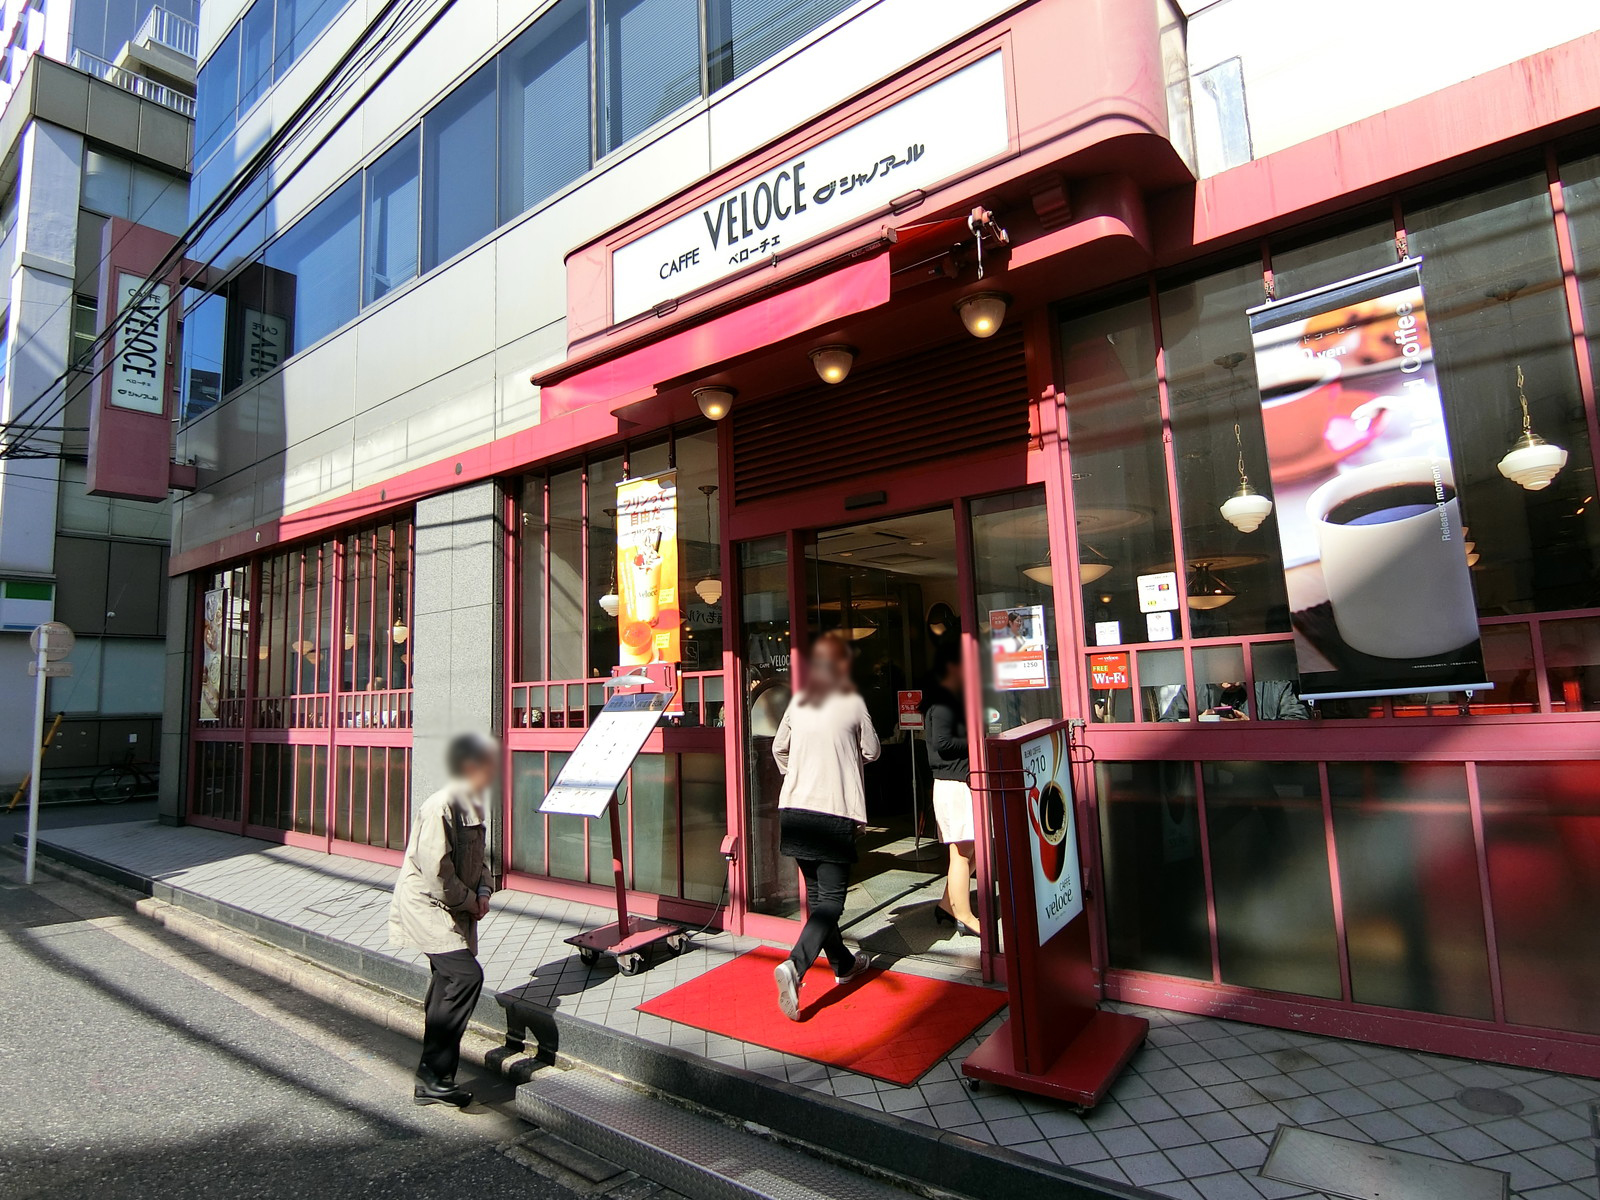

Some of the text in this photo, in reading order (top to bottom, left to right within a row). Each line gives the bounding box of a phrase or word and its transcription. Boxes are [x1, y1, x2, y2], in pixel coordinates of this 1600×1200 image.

[839, 143, 925, 195] シャノアール
[703, 161, 807, 251] VELOCE
[728, 234, 781, 265] ベローチェ
[128, 288, 161, 304] CFE
[122, 305, 160, 379] VELOCE
[1395, 301, 1423, 375] Coffee
[1430, 464, 1445, 500] moment
[1436, 501, 1451, 541] Released
[1093, 671, 1126, 684] Wi-Fi
[1045, 888, 1074, 920] veloce
